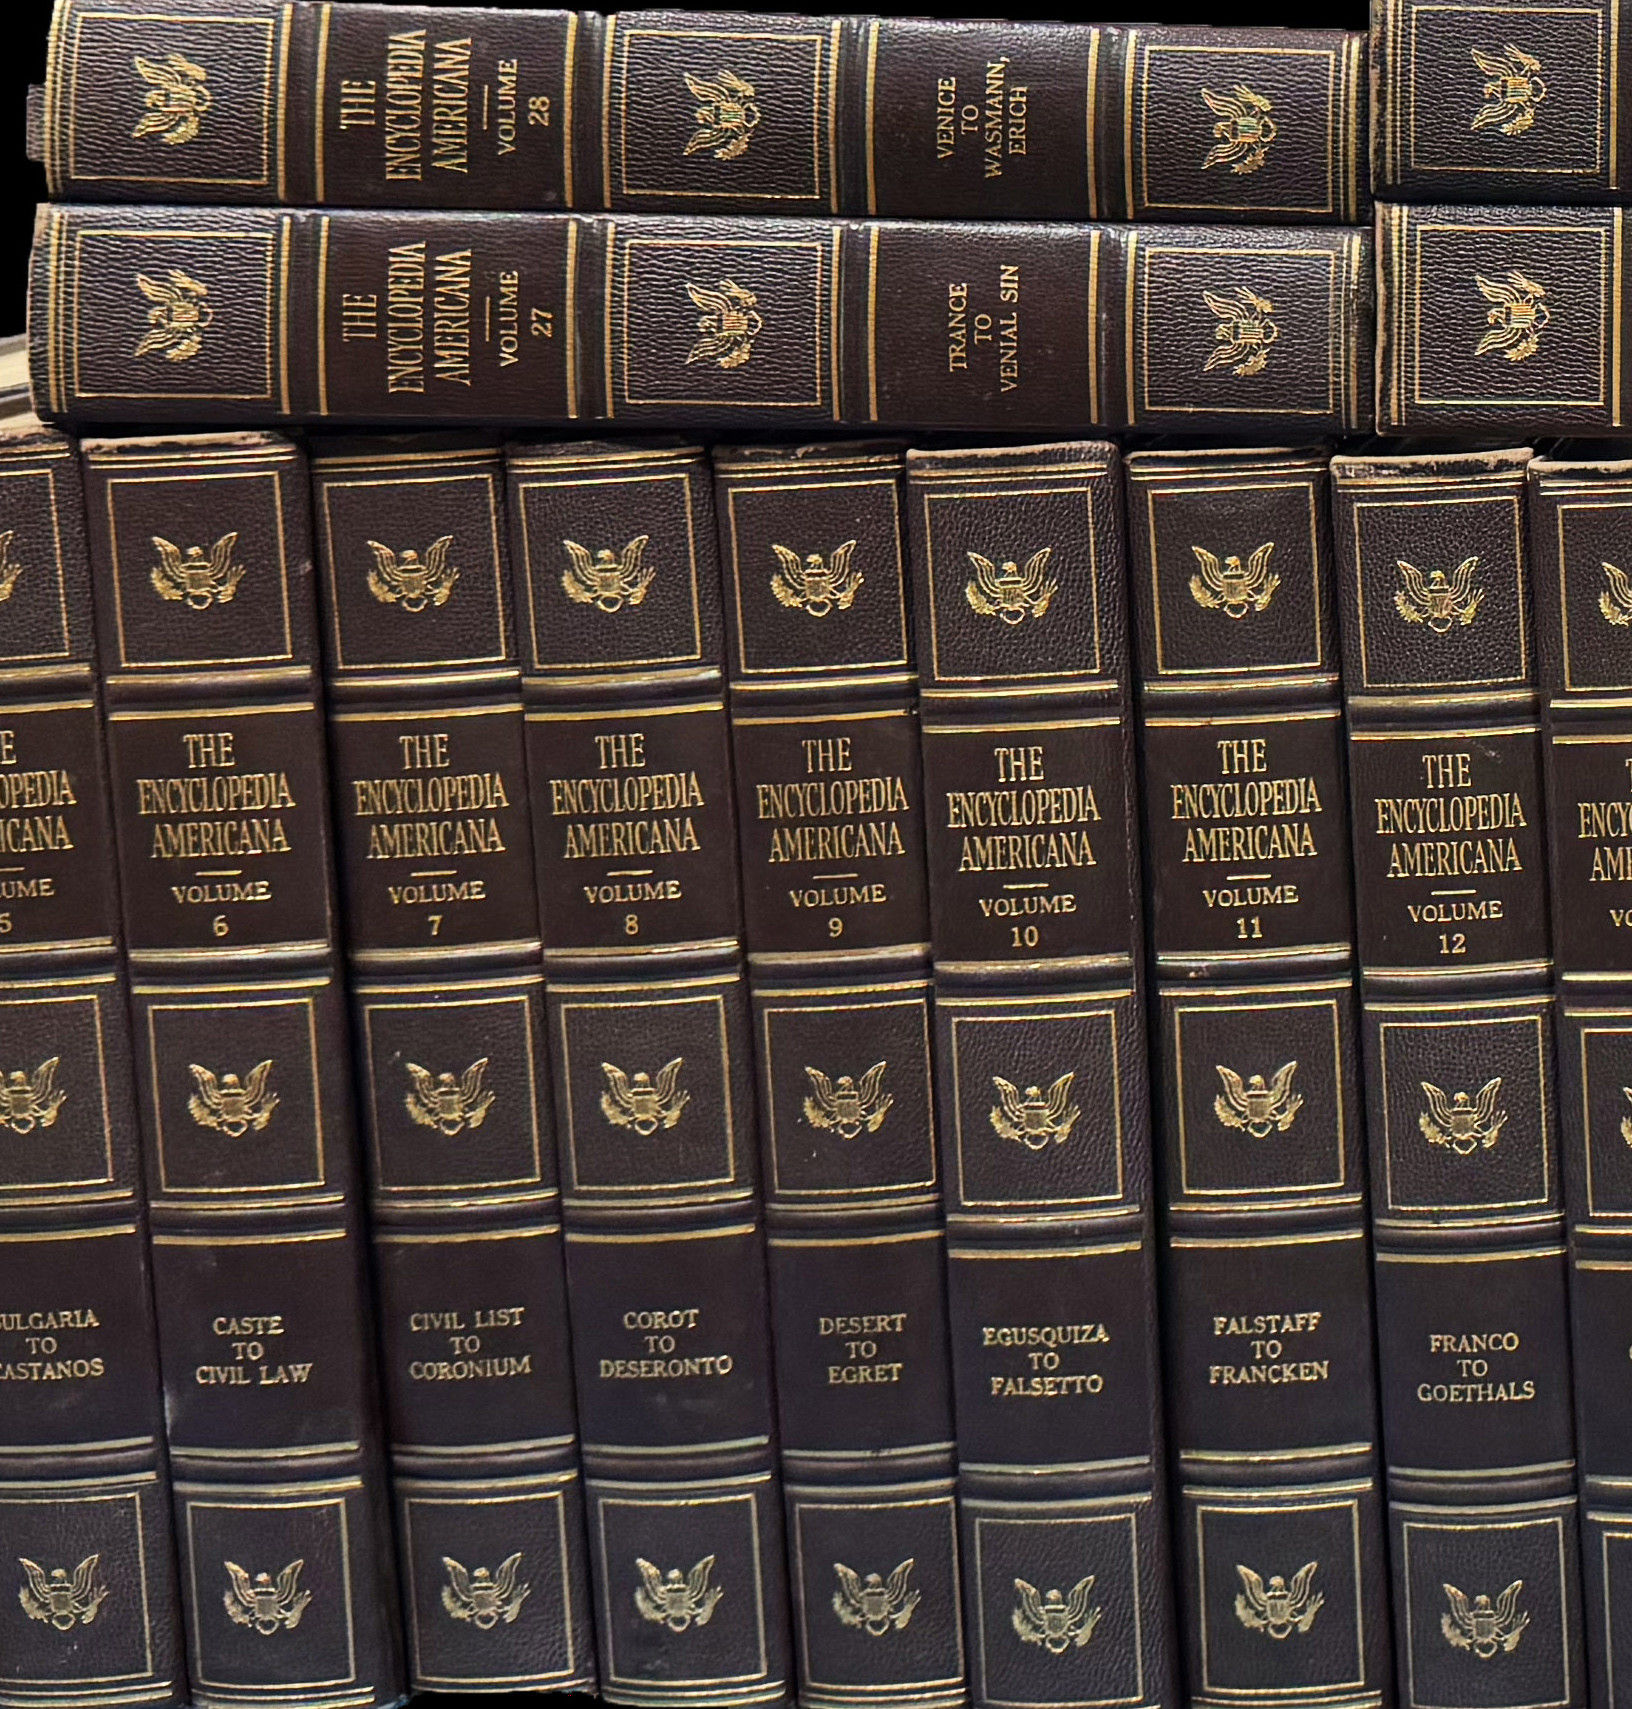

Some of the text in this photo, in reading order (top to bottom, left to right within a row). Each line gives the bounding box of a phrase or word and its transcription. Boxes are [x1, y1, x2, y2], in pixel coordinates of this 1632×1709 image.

[339, 79, 377, 130] THE
[384, 28, 427, 180] ENCYCLOPEDIA
[431, 36, 472, 174] AMERICANA
[496, 58, 518, 156] VOLUME
[527, 96, 550, 127] 28
[936, 76, 957, 159] VENICE
[960, 104, 979, 135] TO
[984, 56, 1011, 178] WASMANN,
[1008, 85, 1029, 155] ERICH
[341, 293, 378, 342] THE
[387, 240, 426, 393] ENCYCLOPEDIA
[433, 248, 472, 386] AMERICANA
[498, 270, 519, 367] VOLUME
[530, 307, 553, 338] 27
[948, 282, 968, 373] TRANCE
[973, 313, 992, 345] TO
[999, 264, 1019, 392] VENIAL SIN
[182, 732, 236, 769] THE
[398, 733, 450, 770] THE
[801, 737, 852, 774] THE
[1217, 738, 1267, 775] THE
[135, 772, 297, 815] ENCYCLOPEDIA
[351, 772, 510, 816] ENCYCLOPEDIA
[549, 770, 705, 816] ENCYCLOPEDIA
[755, 776, 910, 819] ENCYCLOPEDIA
[945, 784, 1102, 829] ENCYCLOPEDIA
[1170, 777, 1323, 820] ENCYCLOPEDIA
[1374, 792, 1528, 834] ENCYCLOPEDIA
[150, 818, 292, 859] AMERICANA
[366, 817, 507, 860] AMERICANA
[563, 816, 702, 859] AMERICANA
[768, 821, 906, 863] AMERICANA
[957, 830, 1097, 872] AMERICANA
[1181, 822, 1318, 863] AMERICANA
[1386, 837, 1523, 878] AMERICANA
[170, 880, 272, 904] VOLUME
[387, 880, 486, 905] VOLUME
[583, 879, 682, 904] VOLUME
[789, 883, 887, 908] VOLUME
[978, 893, 1077, 917] VOLUME
[1202, 884, 1299, 908] VOLUME
[213, 914, 229, 937] 6
[427, 914, 443, 936] 7
[625, 914, 639, 935] 8
[1407, 900, 1504, 923] VOLUME
[828, 917, 843, 938] 9
[1011, 925, 1039, 948] 10
[1236, 916, 1263, 939] 11
[1439, 933, 1466, 954] 12
[212, 1315, 285, 1336] CASTE
[410, 1306, 525, 1332] CIVIL LIST
[623, 1308, 700, 1330] COROT
[819, 1312, 907, 1335] DESERT
[1213, 1311, 1322, 1336] FALSTAFF
[231, 1341, 264, 1361] TO
[644, 1334, 676, 1354] TO
[982, 1323, 1110, 1349] EGUSQUIZA
[1429, 1331, 1520, 1353] FRANCO
[195, 1362, 313, 1385] CIVIL LAW
[409, 1354, 532, 1381] CORONIUM
[599, 1354, 733, 1379] DESERONTO
[828, 1362, 903, 1384] EGRET
[1027, 1351, 1060, 1371] TO
[1209, 1360, 1330, 1385] FRANCKEN
[1456, 1359, 1488, 1378] TO
[990, 1373, 1104, 1397] FALSETTO
[1417, 1380, 1536, 1403] GOETHALS
